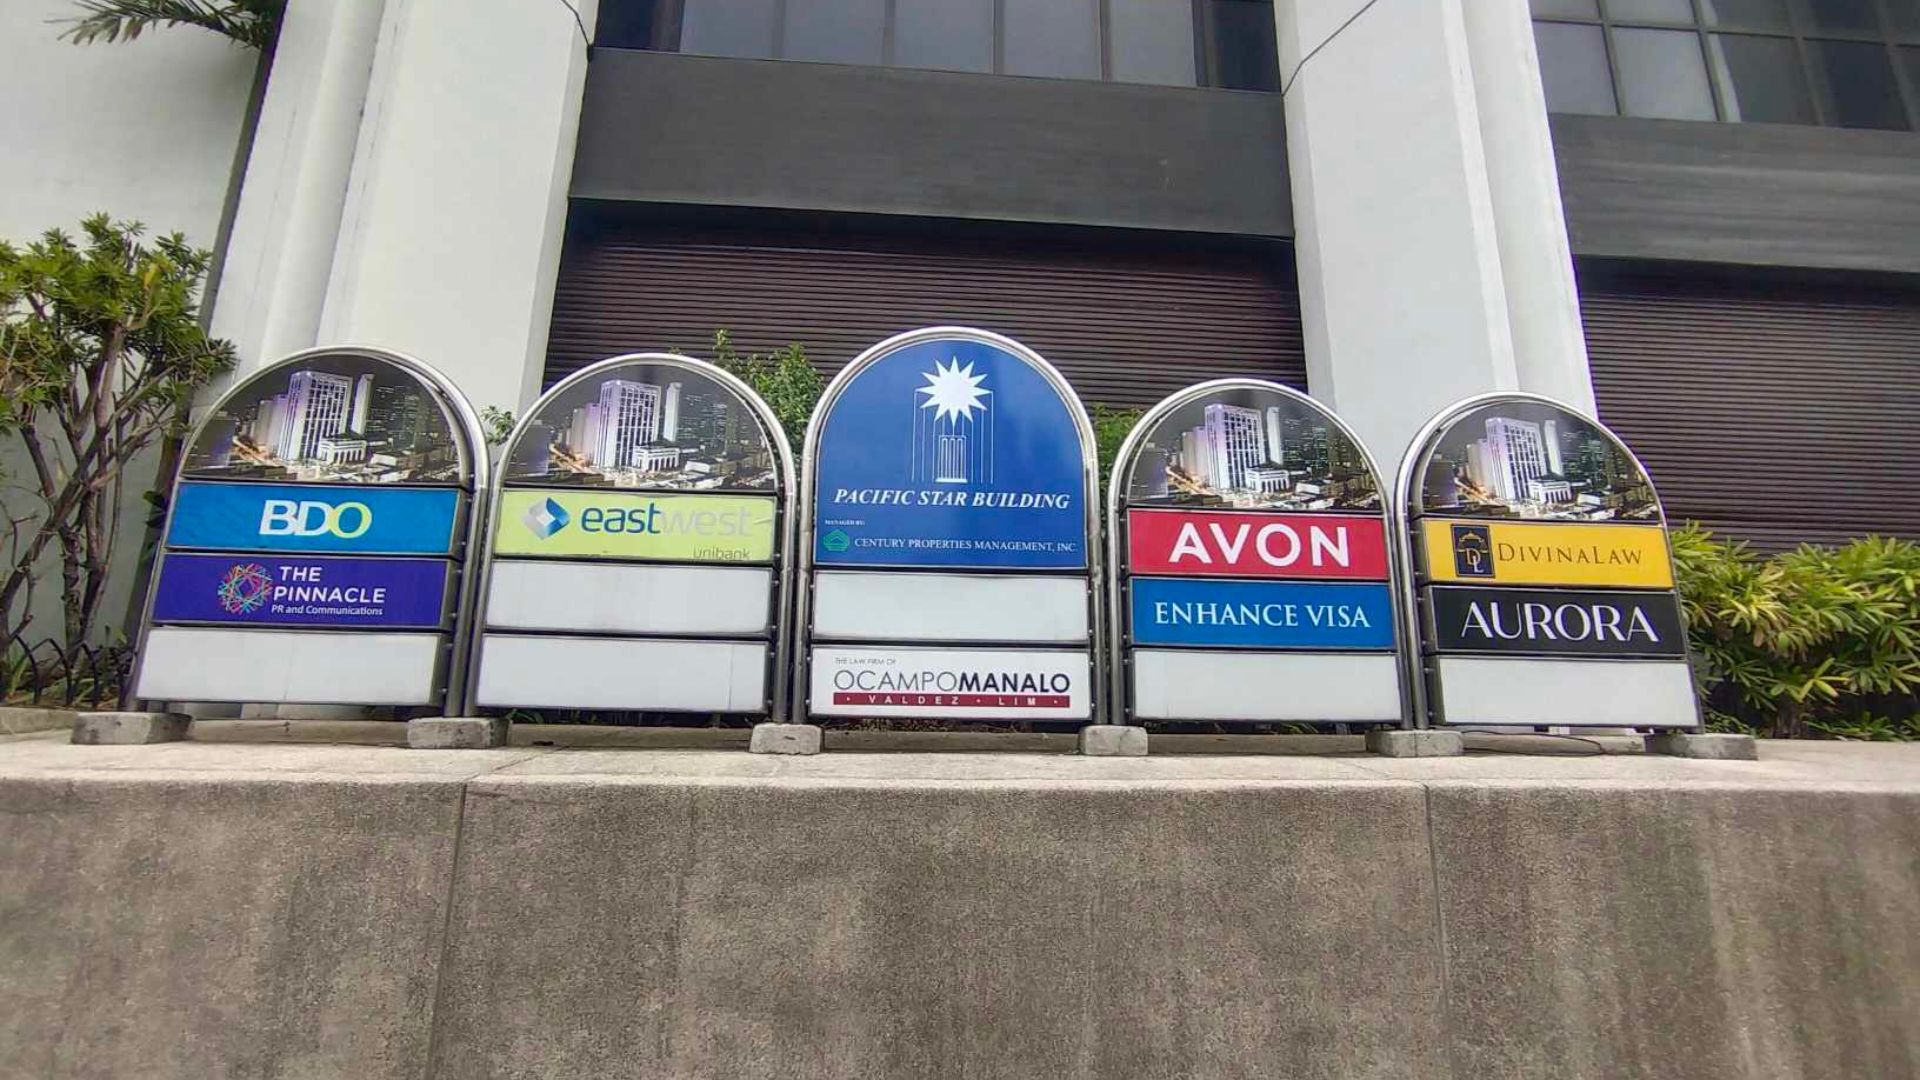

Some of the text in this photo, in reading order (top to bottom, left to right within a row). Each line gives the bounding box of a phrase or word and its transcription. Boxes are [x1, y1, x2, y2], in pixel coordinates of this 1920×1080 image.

[834, 489, 1071, 509] PACIFIC STAR BUILDING
[259, 499, 373, 539] BDO
[692, 546, 751, 560] unibank
[854, 538, 906, 548] CENTURY
[908, 538, 972, 550] PROPERTIES
[974, 539, 1055, 552] MANAGEMENT,
[1168, 522, 1350, 568] AVON
[280, 566, 323, 582] THE
[273, 585, 387, 604] PINNACLE
[271, 604, 383, 616] PR and Communications
[1154, 601, 1372, 628] ENHANCE VISA
[1461, 600, 1660, 643] AURORA
[868, 695, 1036, 706] VALDEZ LIM
